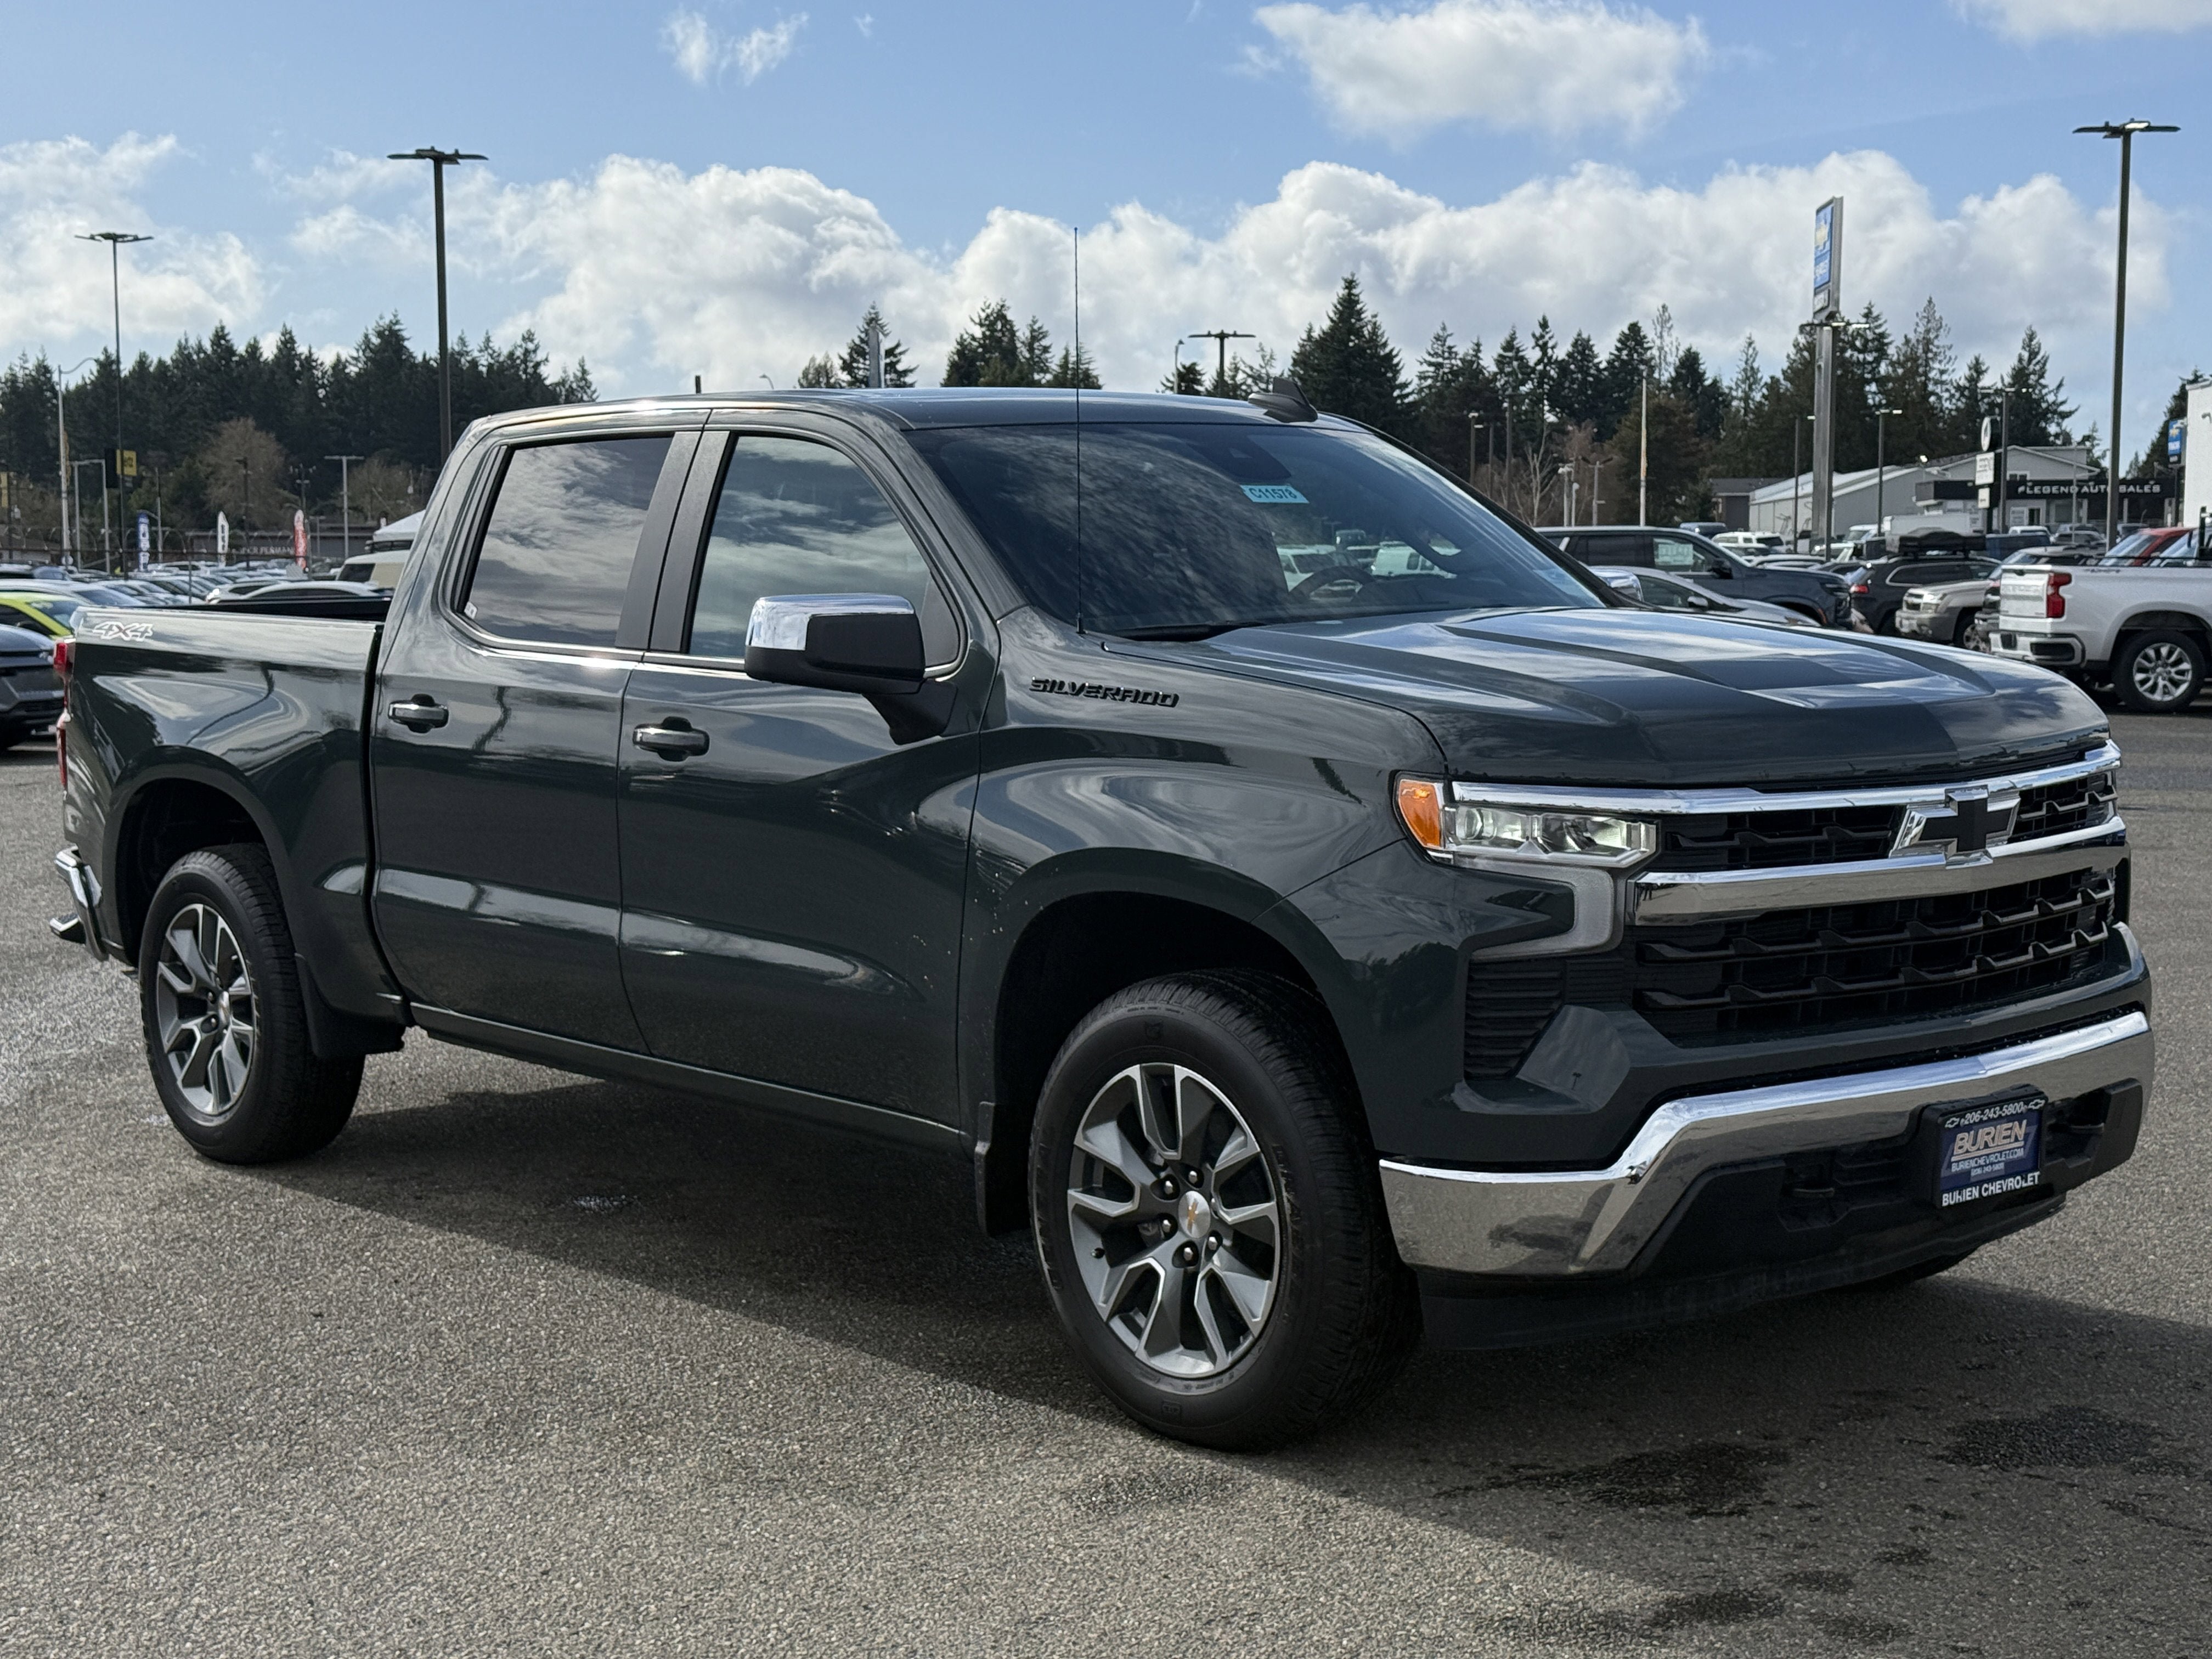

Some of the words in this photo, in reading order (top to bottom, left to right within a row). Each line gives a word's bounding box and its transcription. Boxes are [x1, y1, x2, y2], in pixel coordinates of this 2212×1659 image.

[2027, 485, 2078, 494] LEGEND
[2081, 485, 2110, 493] AUT
[2119, 485, 2160, 493] SALES
[1029, 677, 1180, 708] SILVERADO
[1964, 1101, 2024, 1125] 206-243-5800
[1954, 1119, 2027, 1155] BURIEN
[1951, 1148, 2024, 1172] BURIENCHEVROLET.COM
[1982, 1171, 2040, 1197] CHEVROLET
